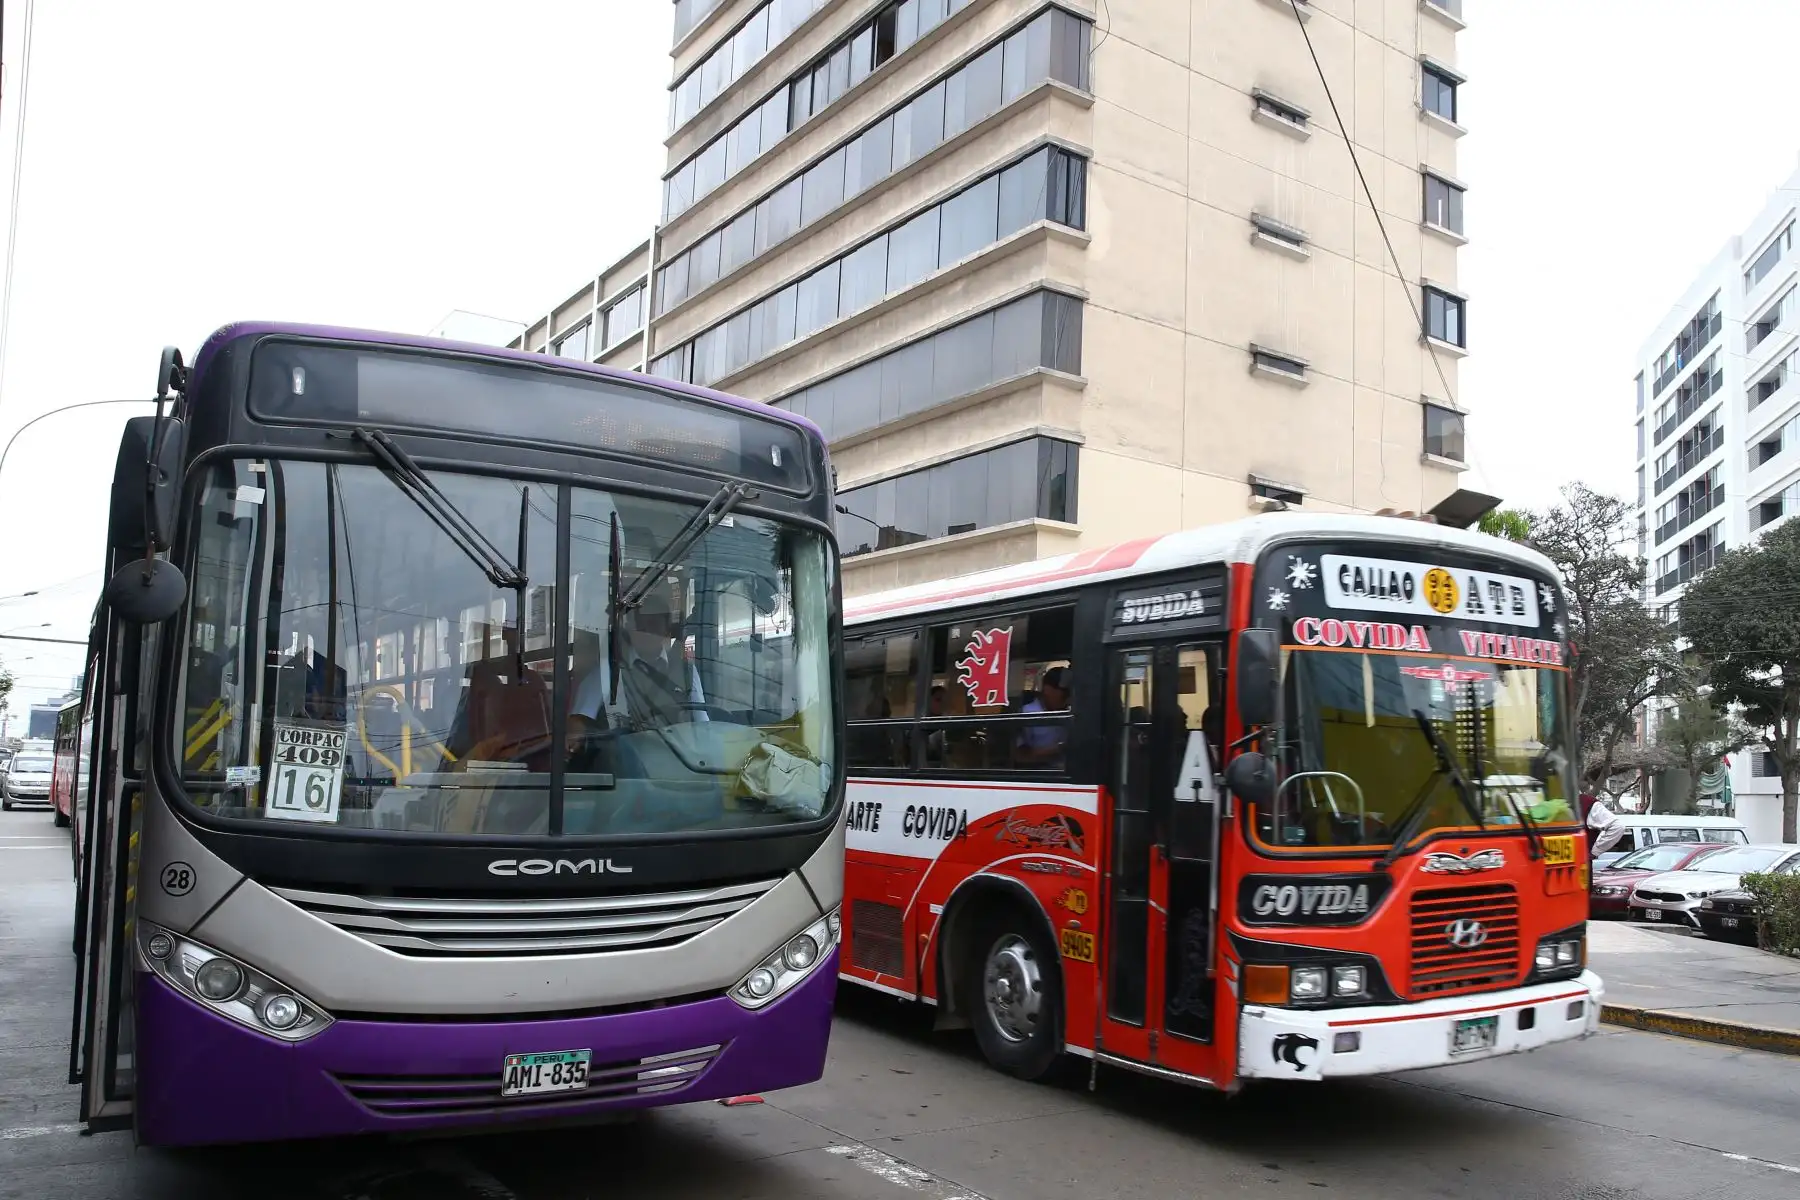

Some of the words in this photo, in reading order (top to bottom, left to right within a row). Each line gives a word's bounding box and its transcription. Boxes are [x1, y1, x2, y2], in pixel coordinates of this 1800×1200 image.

[1339, 563, 1415, 605] CALLAO
[1466, 575, 1526, 616] ATE
[1122, 590, 1204, 622] SUBIDA
[1293, 616, 1431, 652] COVIDA
[1459, 629, 1563, 665] VITARTE
[279, 728, 344, 749] CORPAC
[277, 745, 341, 766] 409
[284, 768, 326, 810] 16
[903, 804, 968, 842] COVIDA
[166, 868, 190, 889] 28
[488, 858, 633, 876] COMIL
[1252, 884, 1369, 916] COVIDA
[507, 1060, 586, 1088] AMI-835
[534, 1053, 565, 1065] PERU
